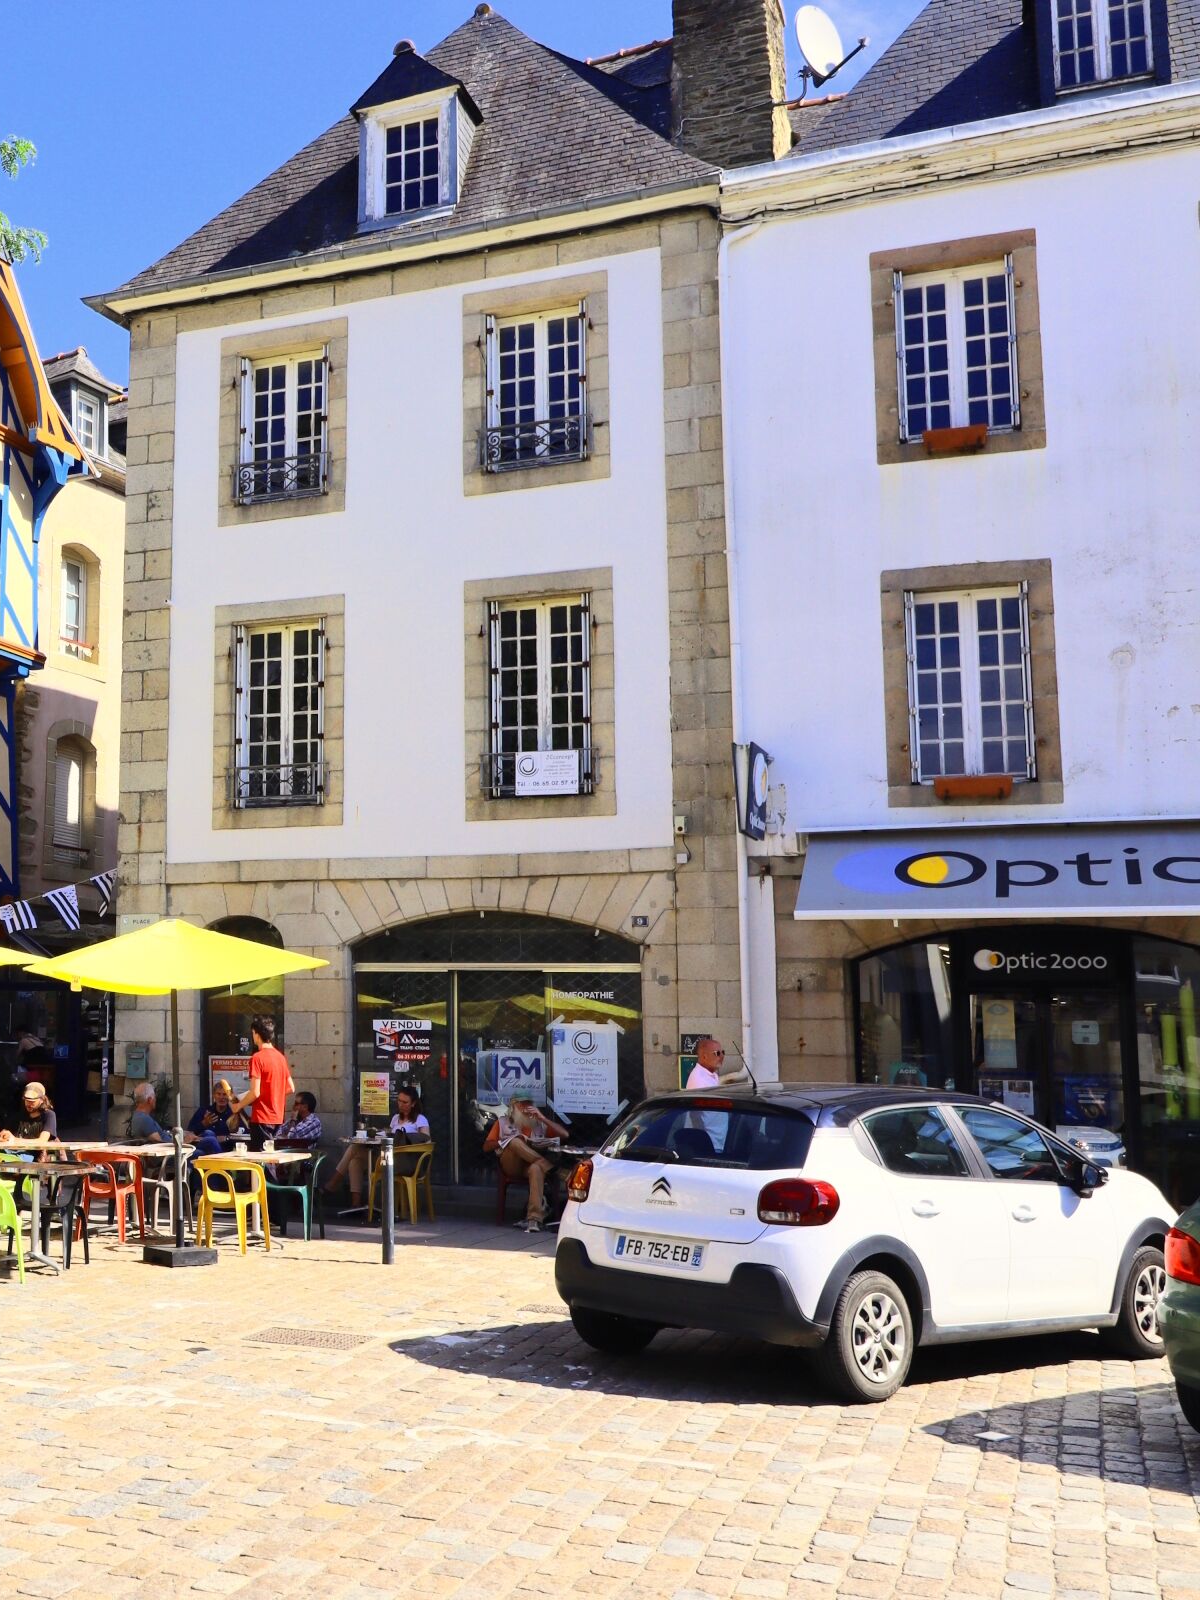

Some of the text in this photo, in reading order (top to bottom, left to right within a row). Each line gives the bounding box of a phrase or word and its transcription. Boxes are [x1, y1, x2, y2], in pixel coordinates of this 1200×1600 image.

[894, 848, 1200, 898] Optic
[636, 917, 643, 926] 9
[990, 951, 1107, 974] Optic 2000
[382, 1020, 422, 1029] VENDU
[572, 1058, 609, 1066] CONCEPT
